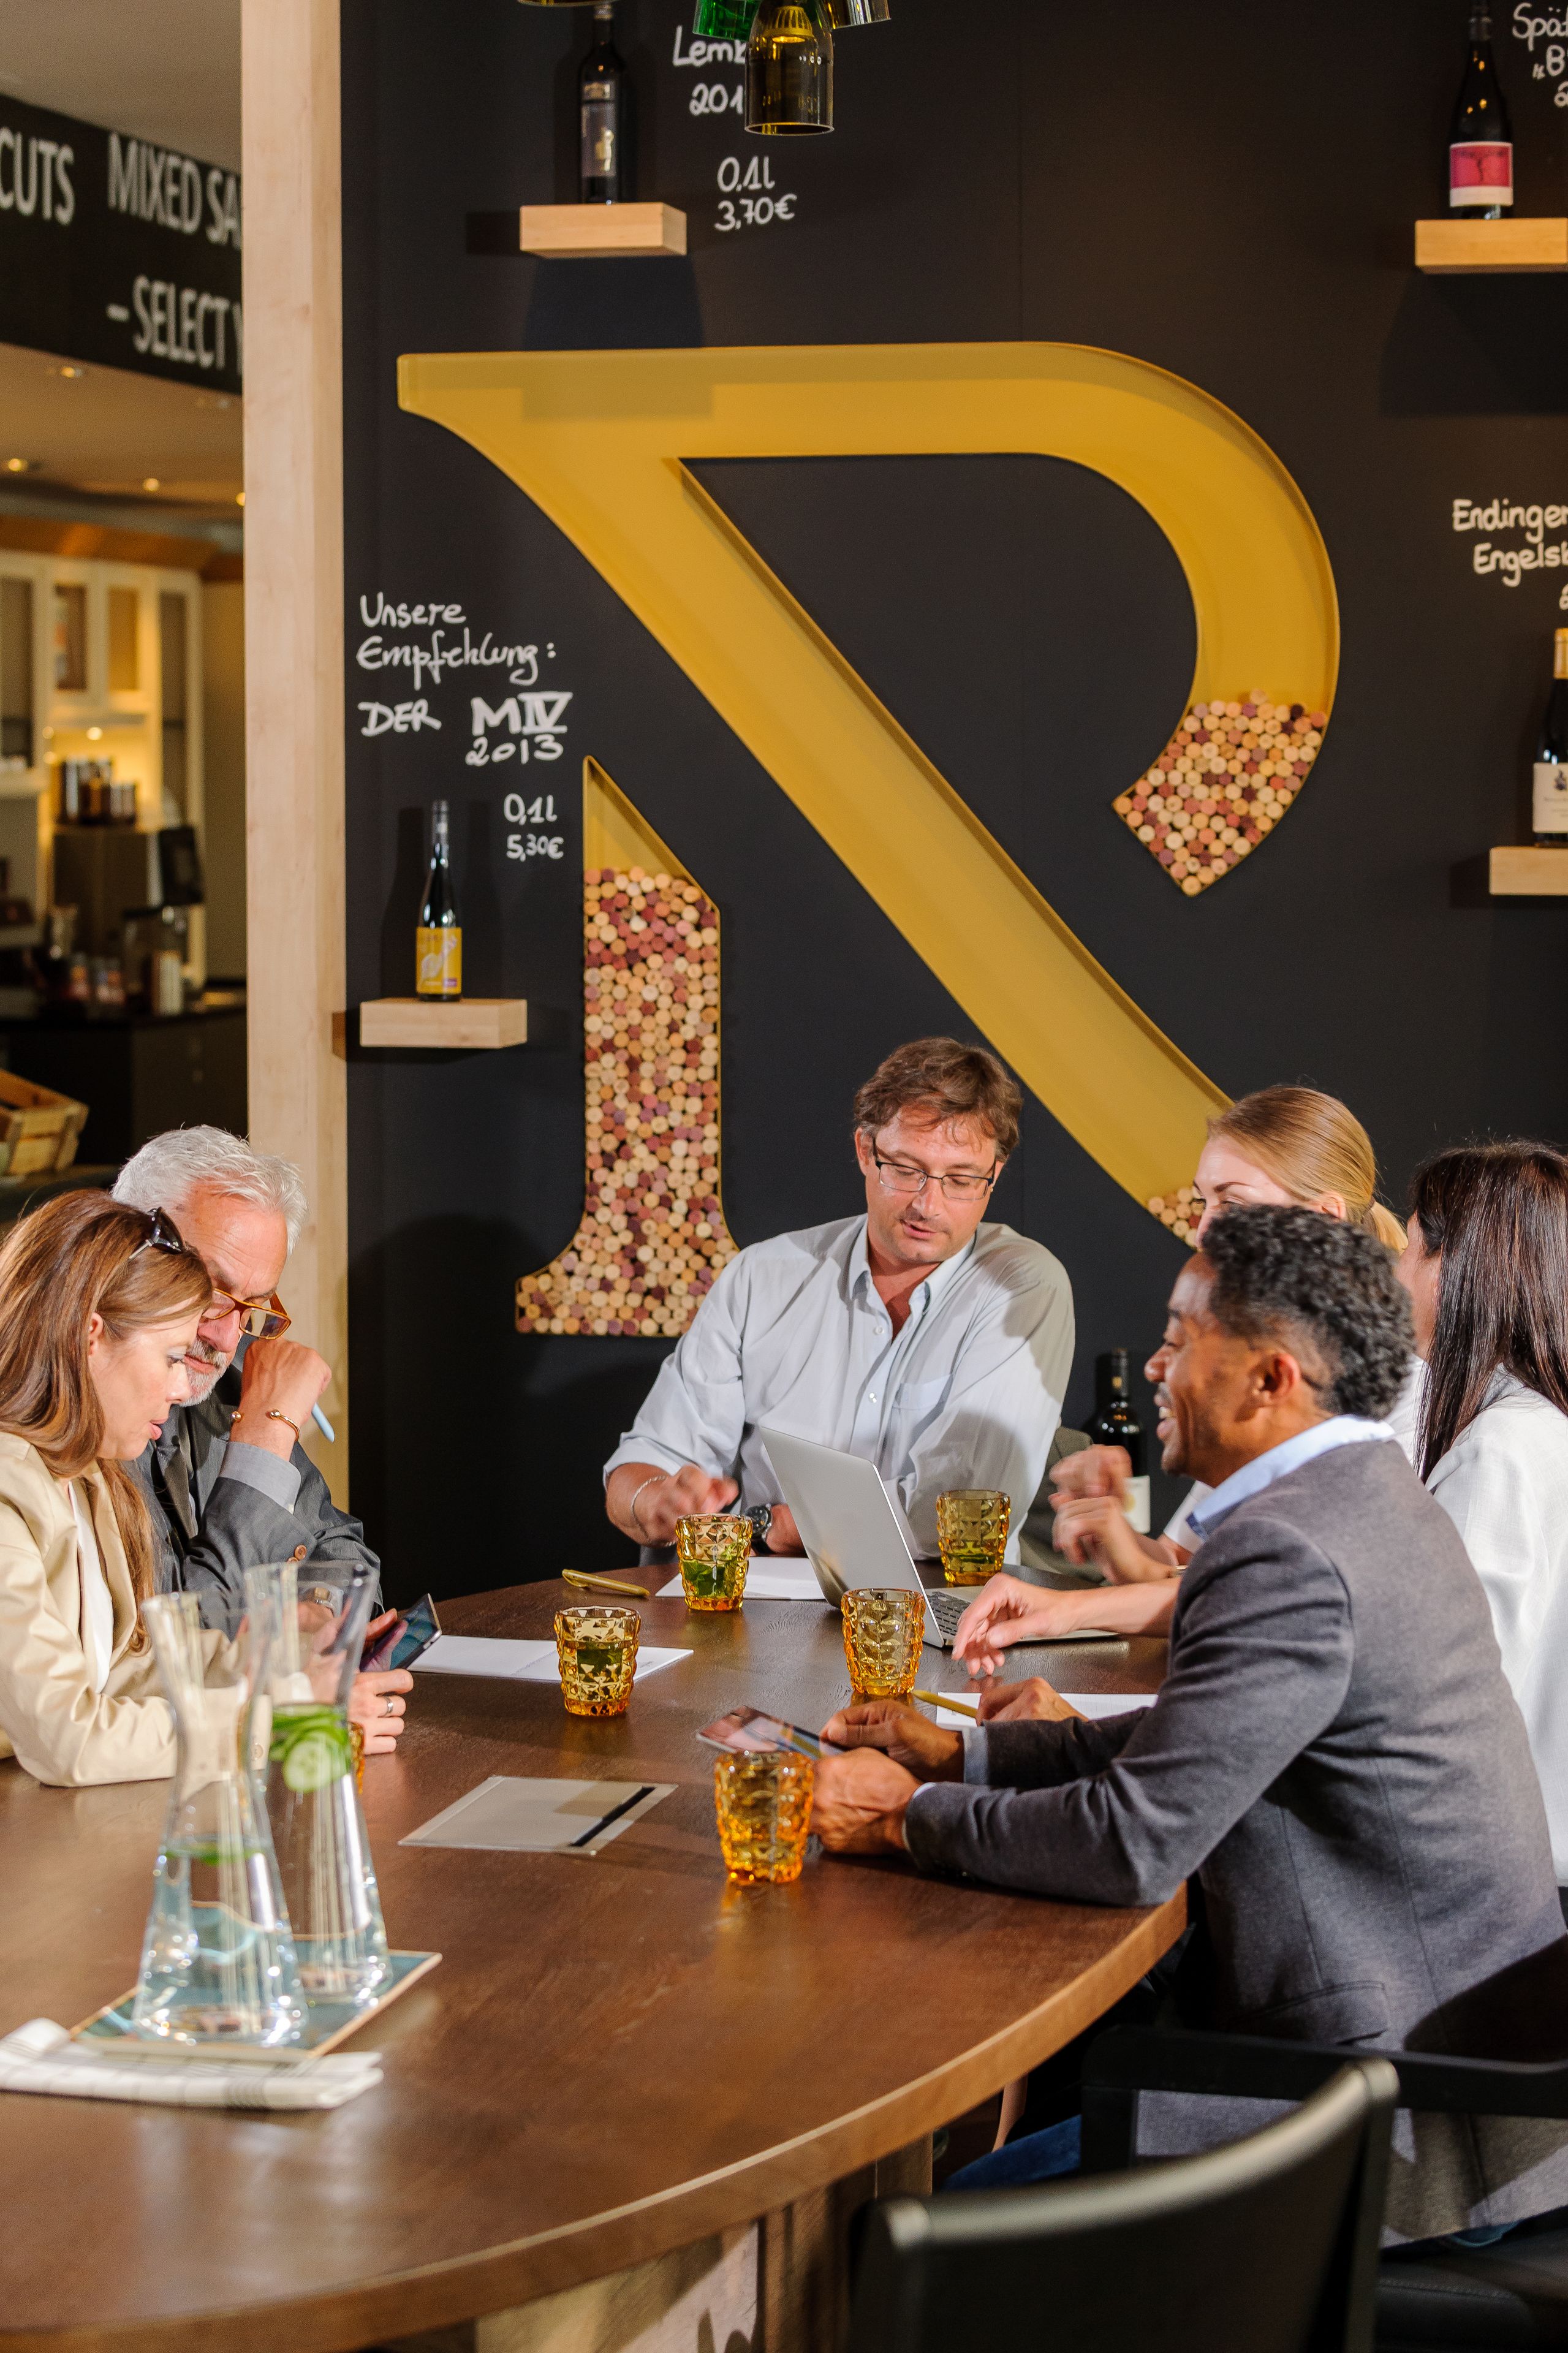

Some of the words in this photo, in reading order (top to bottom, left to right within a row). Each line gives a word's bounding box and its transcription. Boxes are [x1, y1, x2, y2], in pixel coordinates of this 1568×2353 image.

[0, 126, 76, 225] CUTS
[107, 132, 202, 235] MIXED
[714, 194, 798, 232] 3,70€
[360, 592, 466, 629] Unsere
[357, 699, 442, 735] DER
[464, 735, 564, 767] 2013
